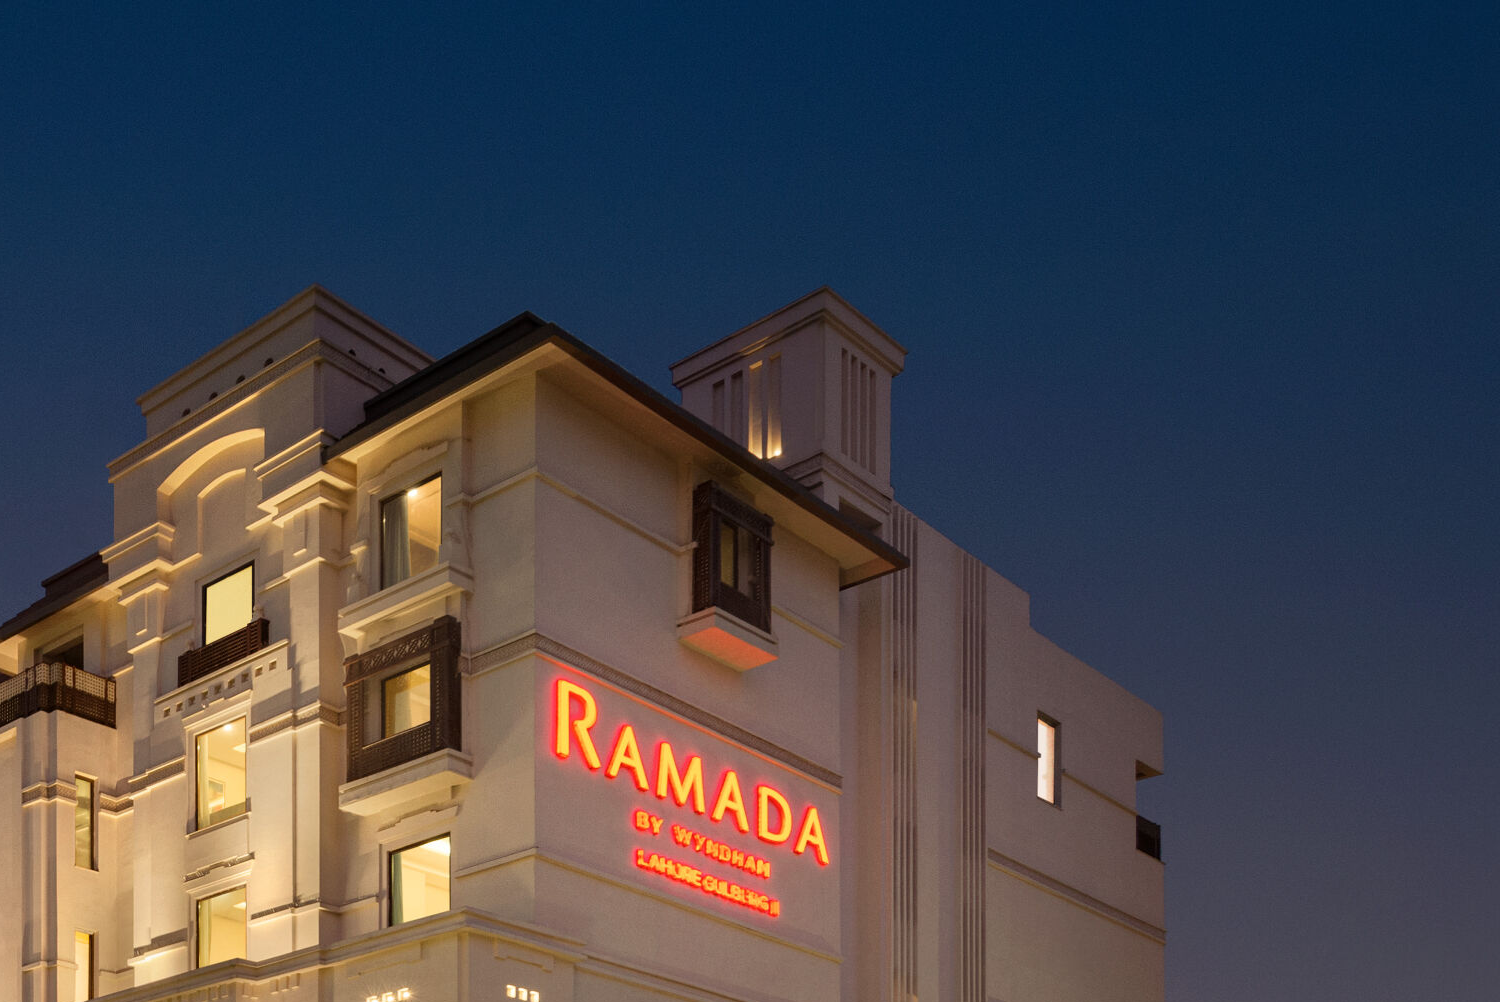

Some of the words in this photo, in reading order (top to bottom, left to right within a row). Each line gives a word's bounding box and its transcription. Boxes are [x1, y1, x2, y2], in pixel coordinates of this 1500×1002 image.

[555, 679, 830, 866] RAMADA
[636, 811, 663, 835] BY
[672, 825, 771, 879] WYNDHAM
